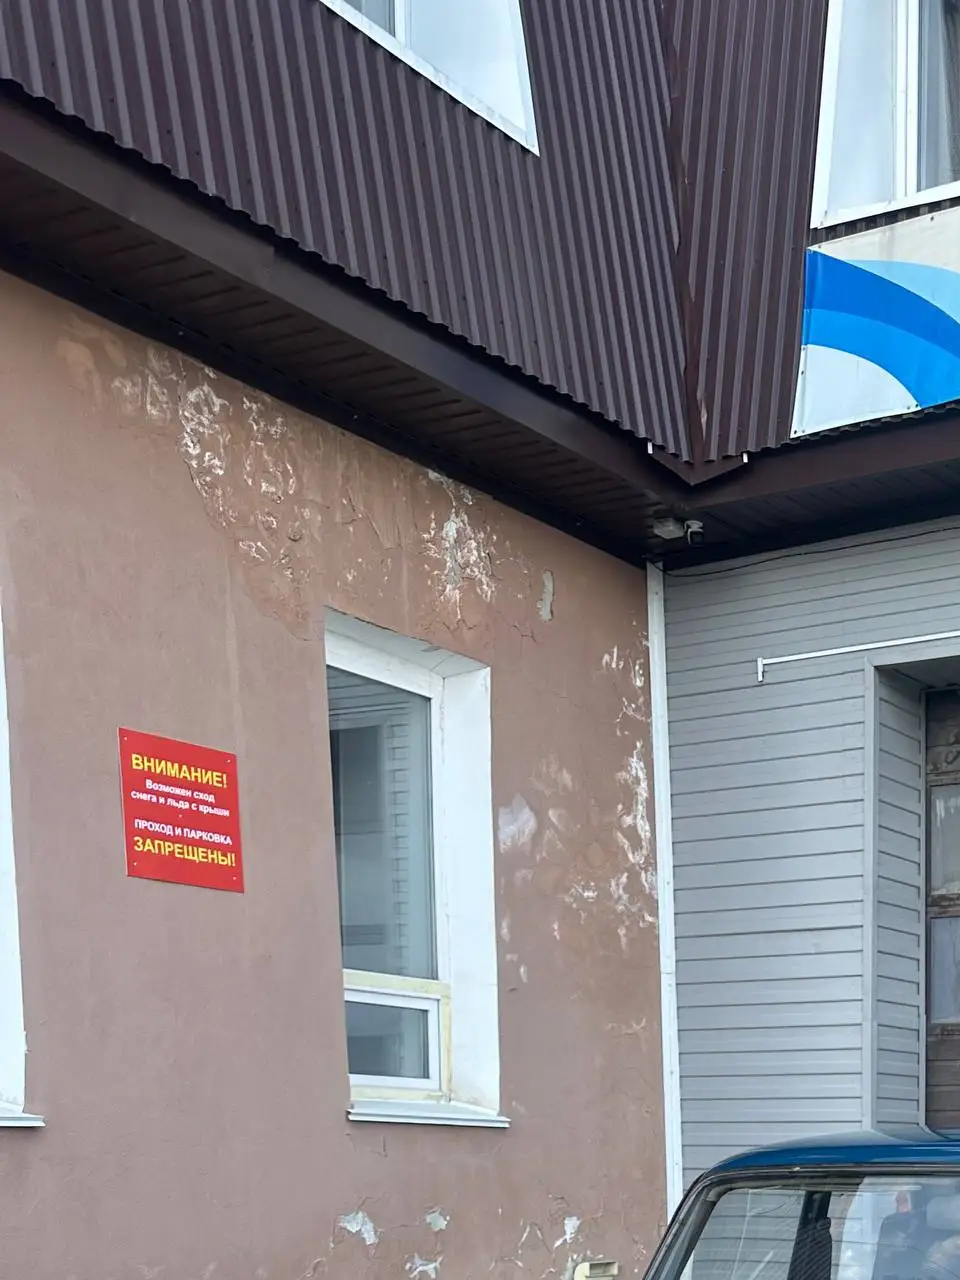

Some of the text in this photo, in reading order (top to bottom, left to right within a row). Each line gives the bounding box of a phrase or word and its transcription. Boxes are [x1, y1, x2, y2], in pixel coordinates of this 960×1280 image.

[131, 753, 227, 788] ВНИМАНИЕ!
[130, 791, 157, 803] снега
[159, 796, 165, 804] и
[167, 798, 190, 809] льда
[198, 804, 230, 816] крыши
[145, 778, 215, 803] Возможен сход
[134, 819, 232, 845] ПРОХОД И ПАРКОВКА
[133, 836, 236, 866] ЗАПРЕЩЕНЫ!
